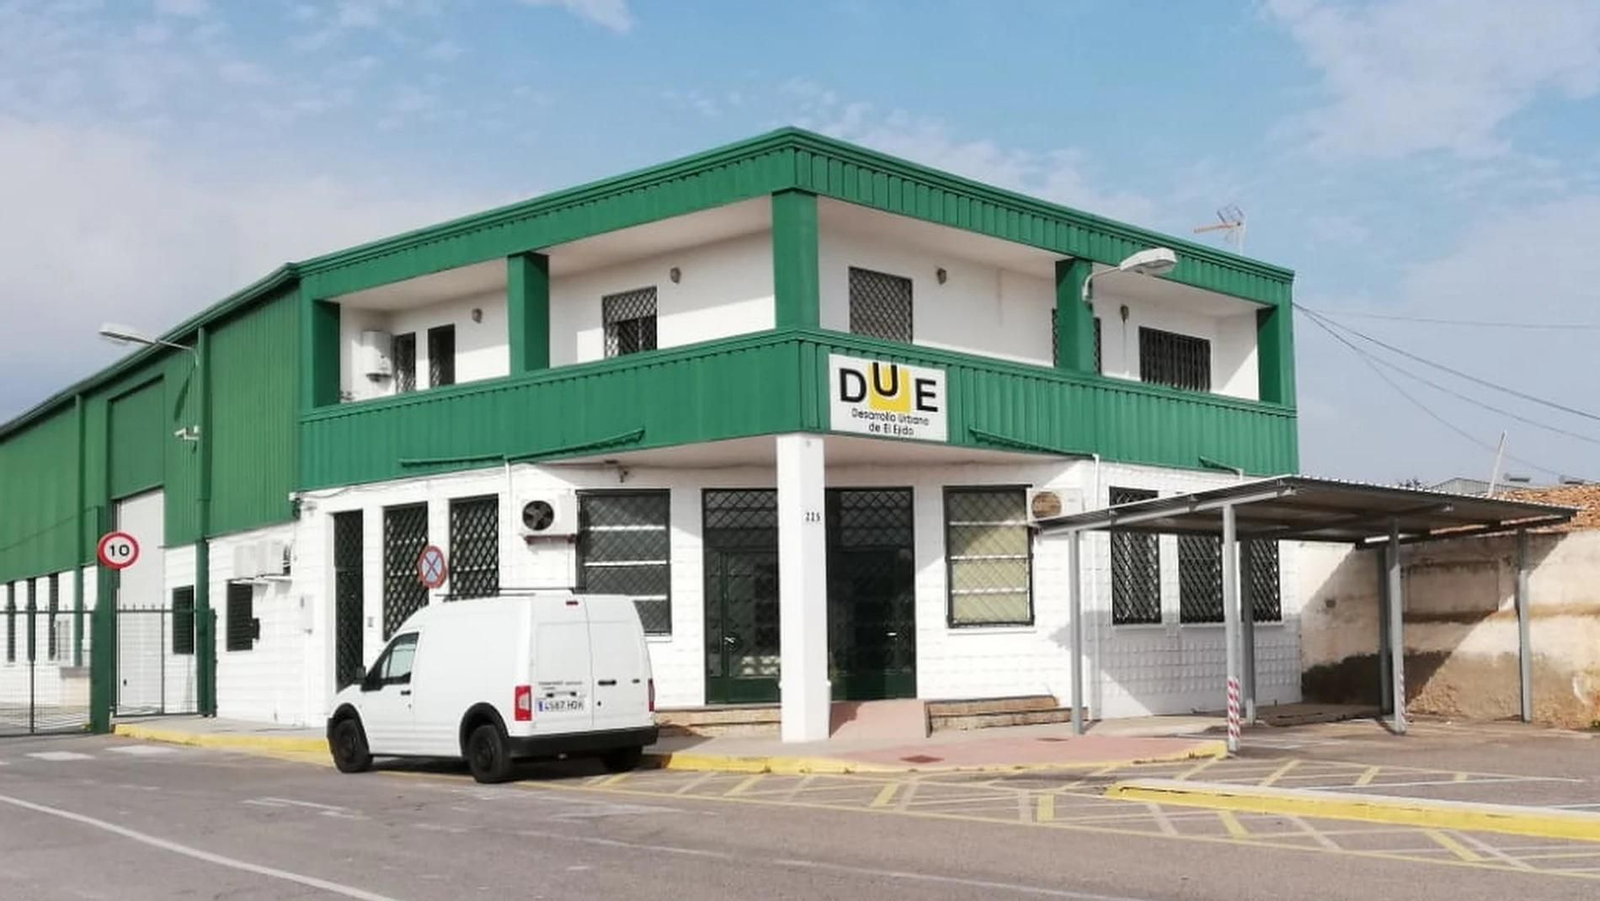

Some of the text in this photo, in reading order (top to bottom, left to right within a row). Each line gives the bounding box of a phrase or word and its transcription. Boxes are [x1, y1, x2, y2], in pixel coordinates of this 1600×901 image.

[839, 362, 938, 412] DUE
[852, 408, 929, 427] Desarrollo Urbano
[869, 423, 914, 436] de El Ejido
[109, 544, 130, 557] 10
